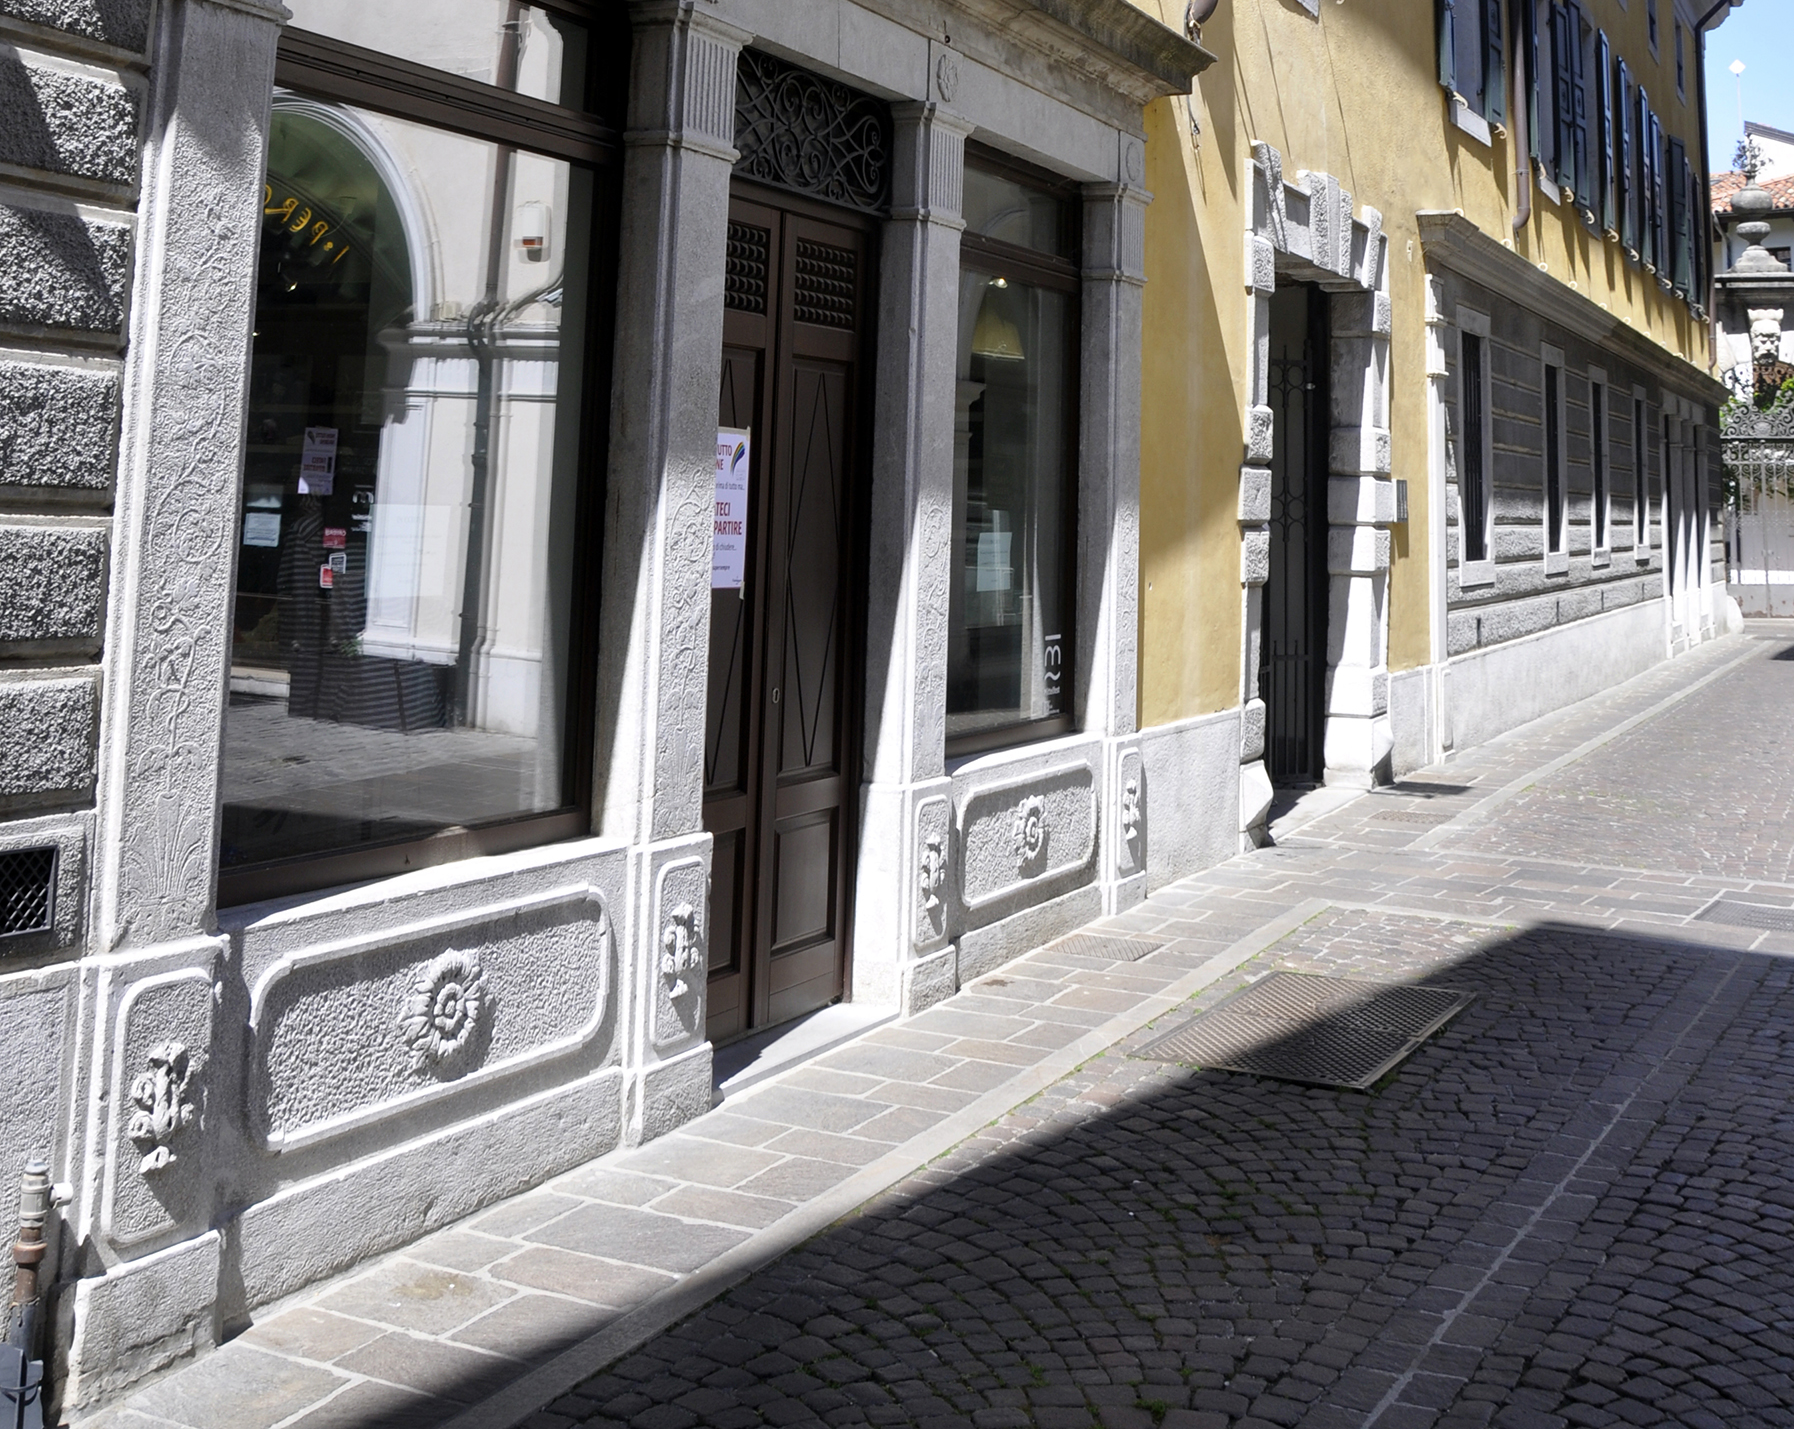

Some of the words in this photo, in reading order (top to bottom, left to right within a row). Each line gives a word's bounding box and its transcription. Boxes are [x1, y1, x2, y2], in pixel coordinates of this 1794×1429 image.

[717, 444, 732, 456] UTTO
[715, 502, 731, 517] TECI
[713, 520, 742, 535] PARTIRE
